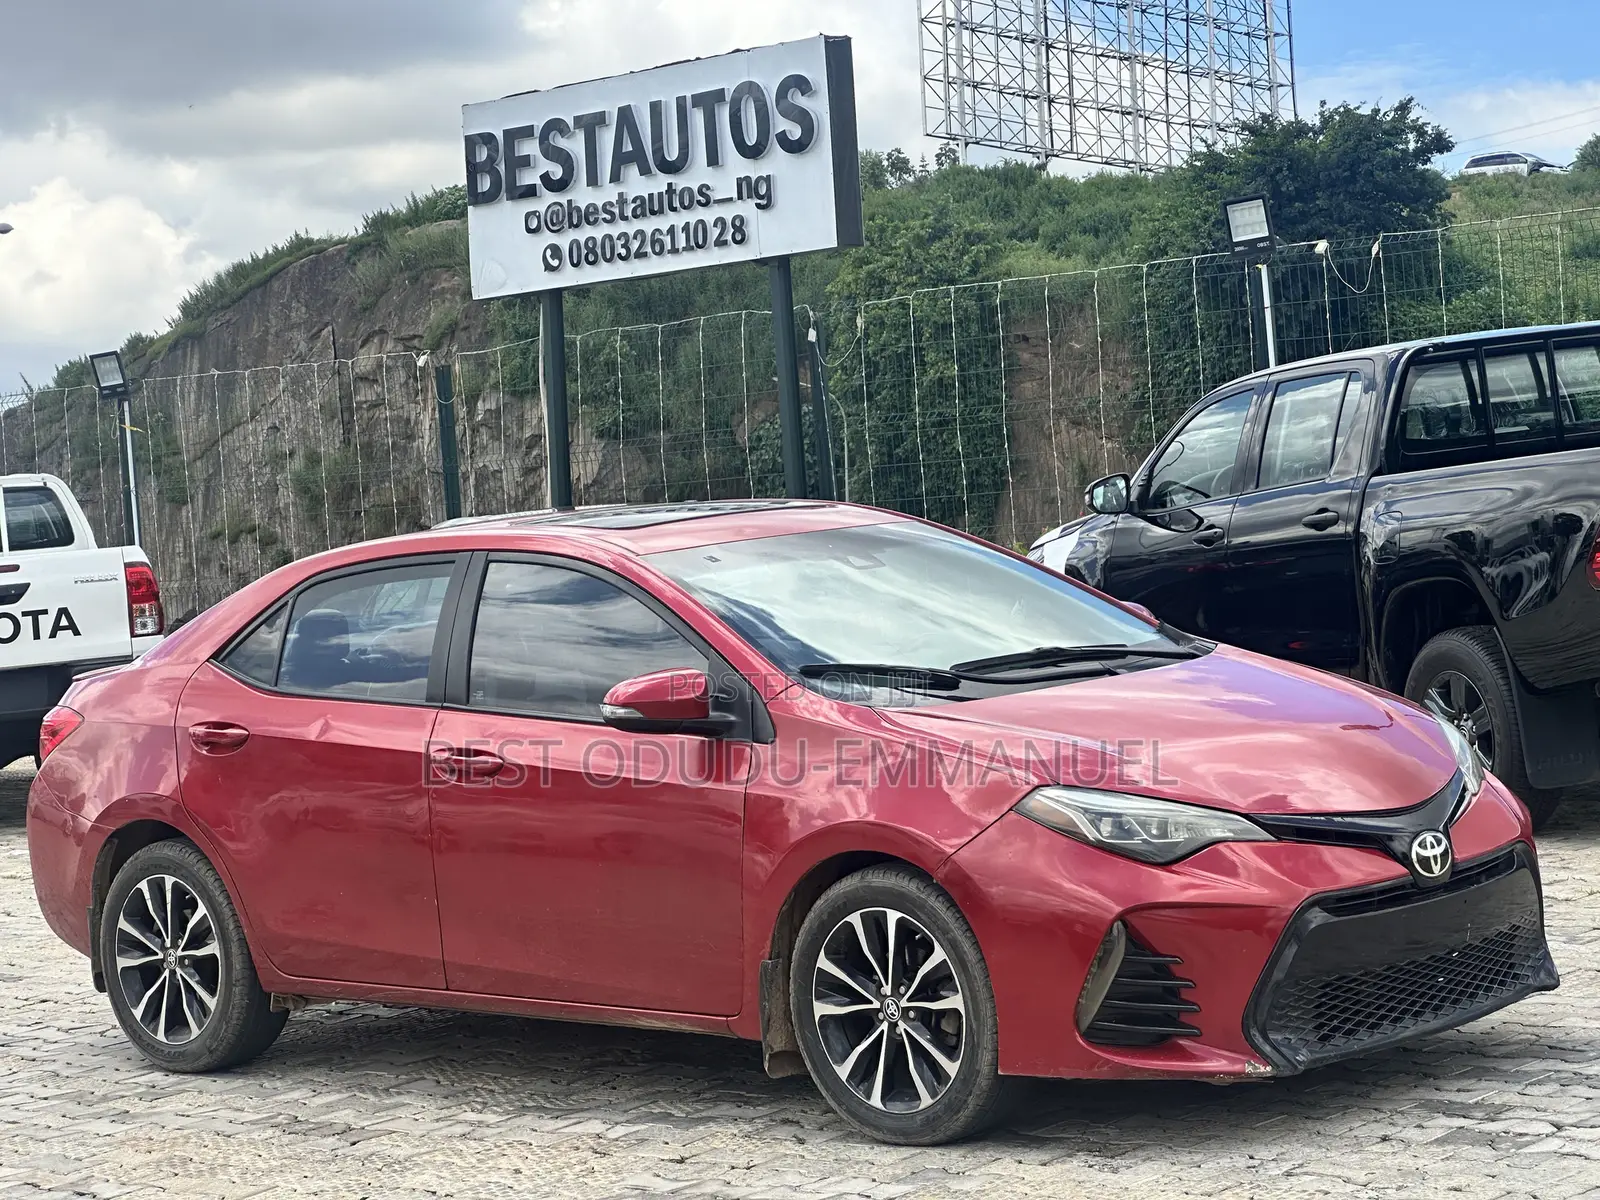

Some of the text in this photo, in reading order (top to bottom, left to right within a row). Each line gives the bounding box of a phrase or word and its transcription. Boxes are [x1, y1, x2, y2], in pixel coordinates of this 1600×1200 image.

[465, 73, 817, 206] BESTAUTOS
[544, 174, 773, 233] @bestautos_ng
[568, 214, 748, 268] 08032611028
